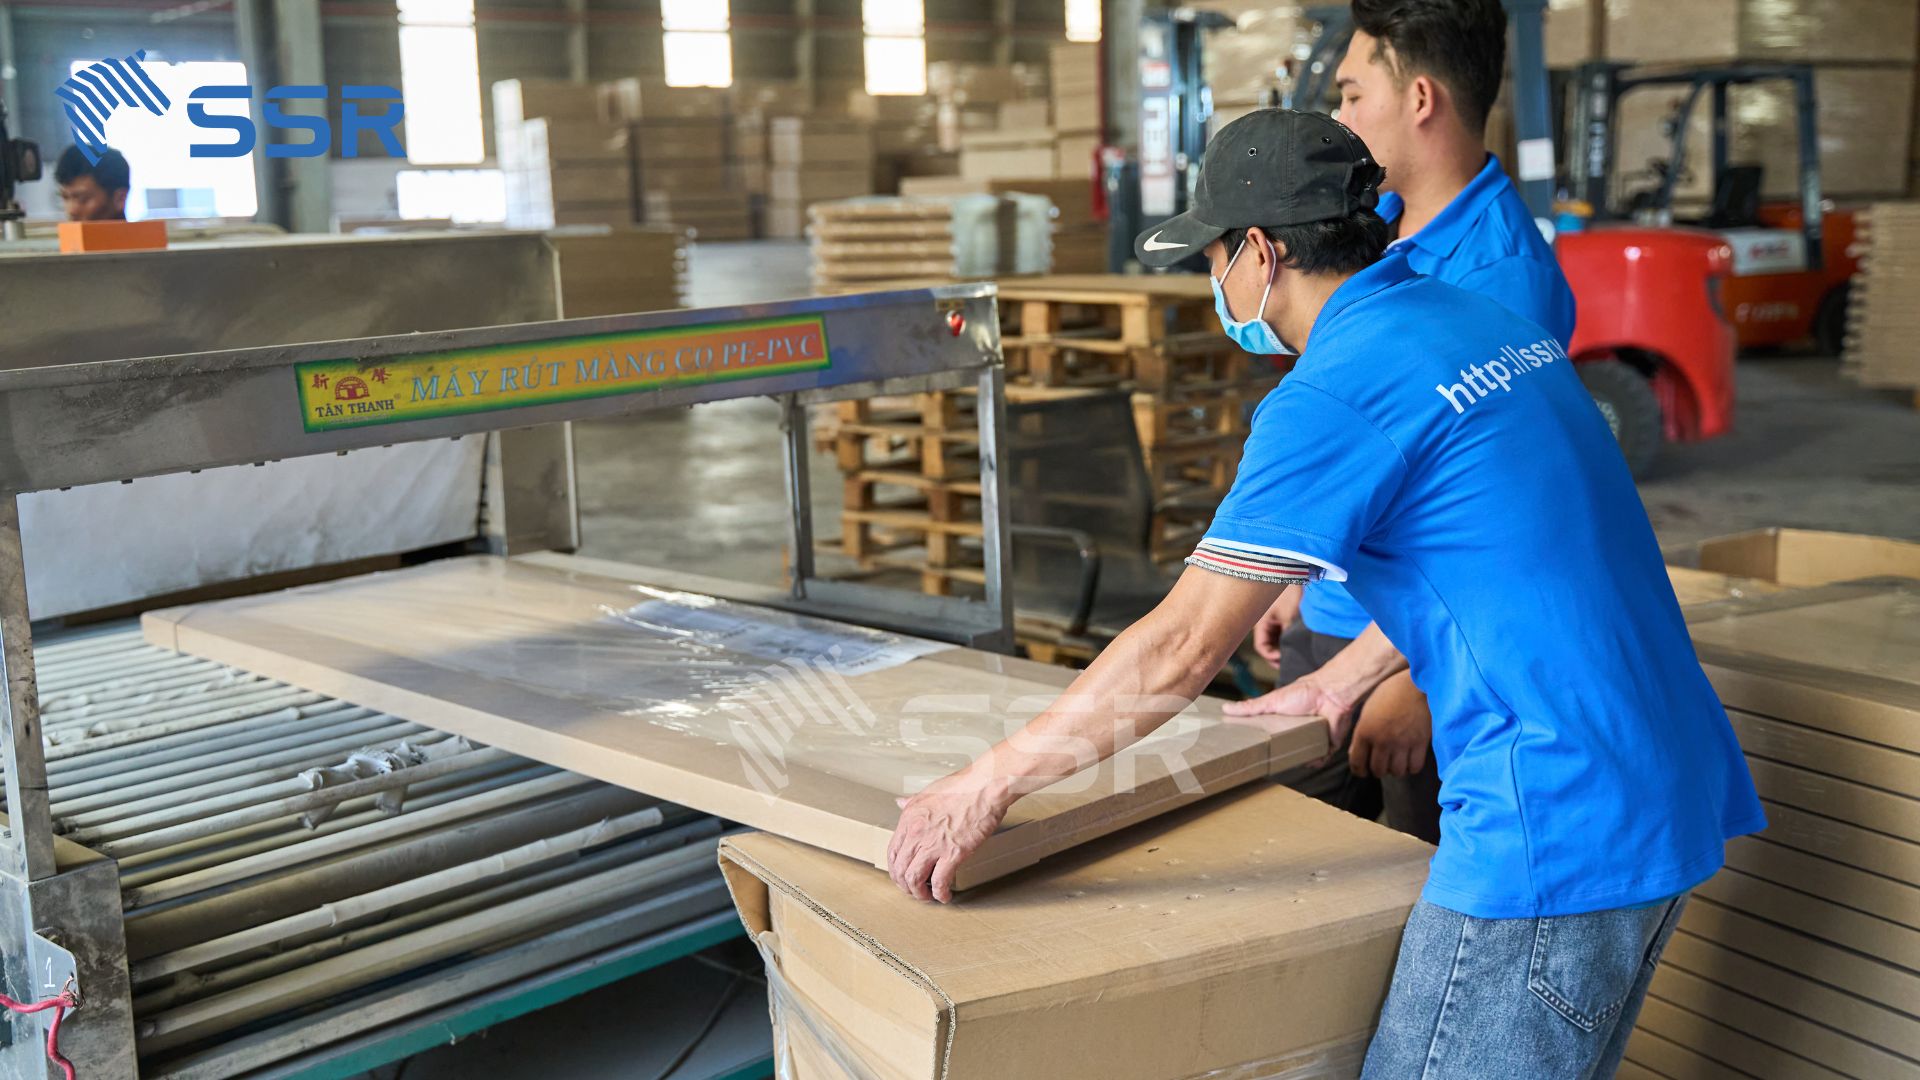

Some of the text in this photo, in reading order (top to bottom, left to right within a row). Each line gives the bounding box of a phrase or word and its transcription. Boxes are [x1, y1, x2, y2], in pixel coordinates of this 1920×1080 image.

[410, 365, 489, 402] MÁY
[499, 355, 566, 392] RÚT
[575, 350, 666, 384] MÀNG
[723, 333, 817, 367] PE-PVC
[315, 402, 344, 418] TÂN
[347, 399, 395, 415] THANH
[43, 956, 56, 988] 1
